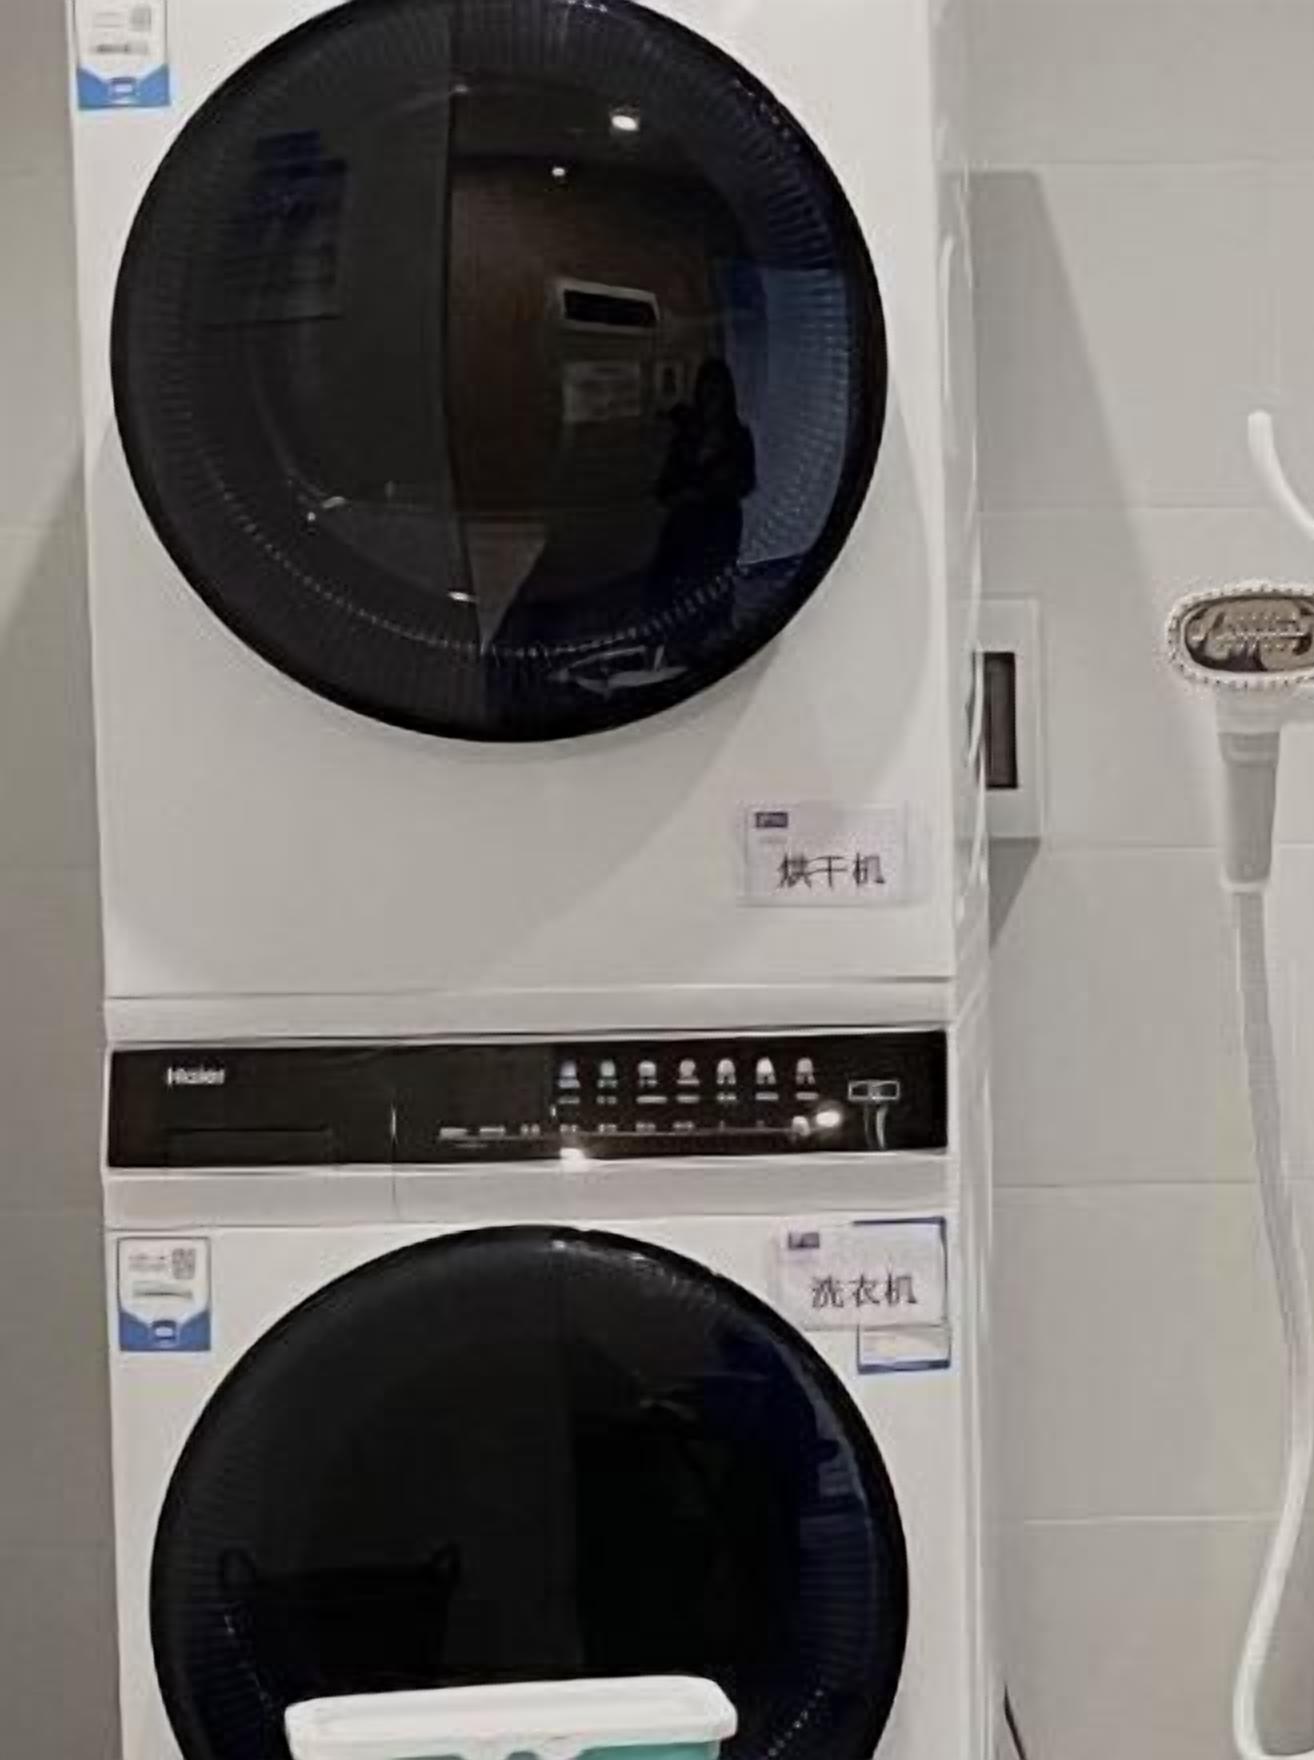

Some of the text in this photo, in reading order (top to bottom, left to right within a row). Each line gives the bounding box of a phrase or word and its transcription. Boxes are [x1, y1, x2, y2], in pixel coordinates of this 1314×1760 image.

[777, 852, 885, 889] 烘干机
[812, 1271, 918, 1309] 洗衣机
